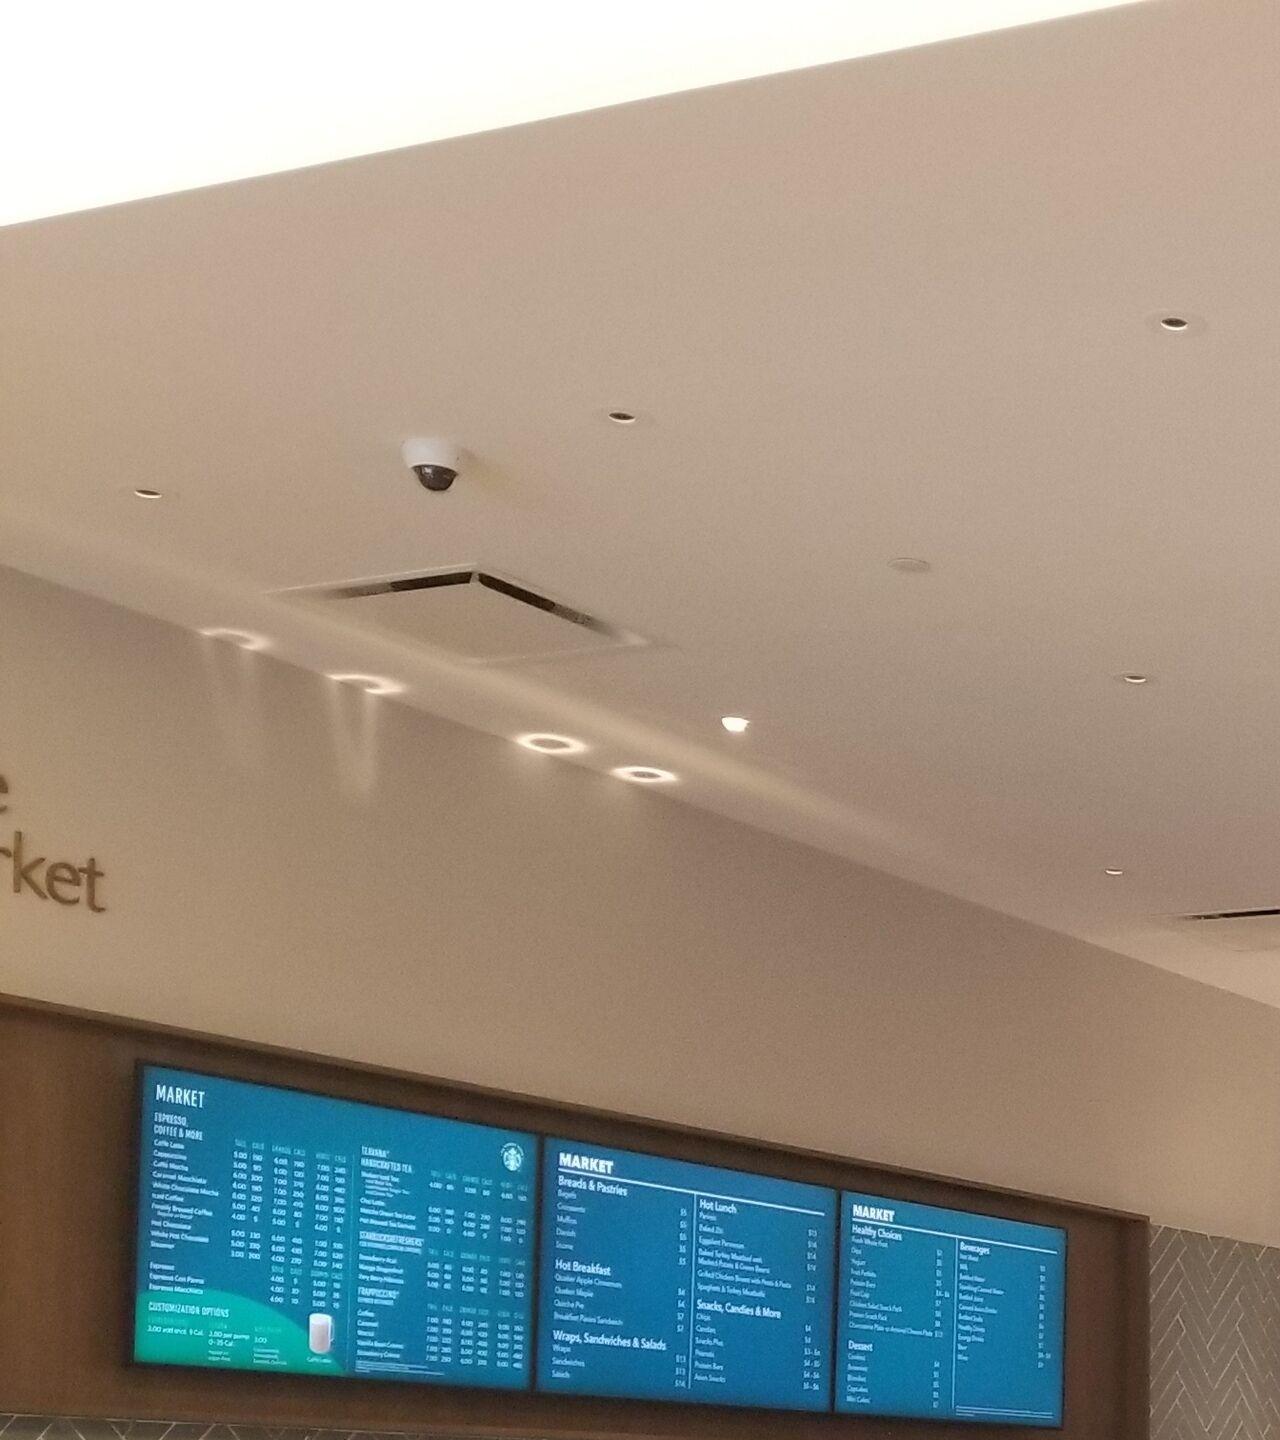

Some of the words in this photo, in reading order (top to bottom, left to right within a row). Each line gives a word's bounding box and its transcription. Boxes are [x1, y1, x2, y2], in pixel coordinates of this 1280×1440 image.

[156, 1085, 205, 1108] MARKET
[154, 1124, 178, 1138] COFFEE
[178, 1128, 184, 1138] &
[185, 1129, 203, 1141] MORE
[559, 1152, 614, 1174] MARKET
[558, 1175, 587, 1190] Breads
[588, 1179, 595, 1191] &
[597, 1182, 628, 1197] Pastries
[699, 1199, 714, 1211] Hot
[715, 1201, 737, 1214] Lunch
[852, 1204, 895, 1222] MARKET
[852, 1224, 877, 1239] Healthy
[877, 1228, 903, 1241] Choices
[555, 1259, 571, 1271] Hot
[572, 1261, 611, 1276] Breakfast
[148, 1301, 200, 1315] CUSTOMIZATION
[201, 1305, 230, 1318] OPTIONS
[697, 1299, 724, 1314] Snacks,
[725, 1303, 754, 1317] Candies
[755, 1306, 762, 1317] &
[762, 1308, 782, 1320] More
[552, 1330, 582, 1345] Wraps,
[583, 1332, 631, 1348] Sandwiches
[632, 1337, 640, 1349] &
[640, 1338, 667, 1351] Salads
